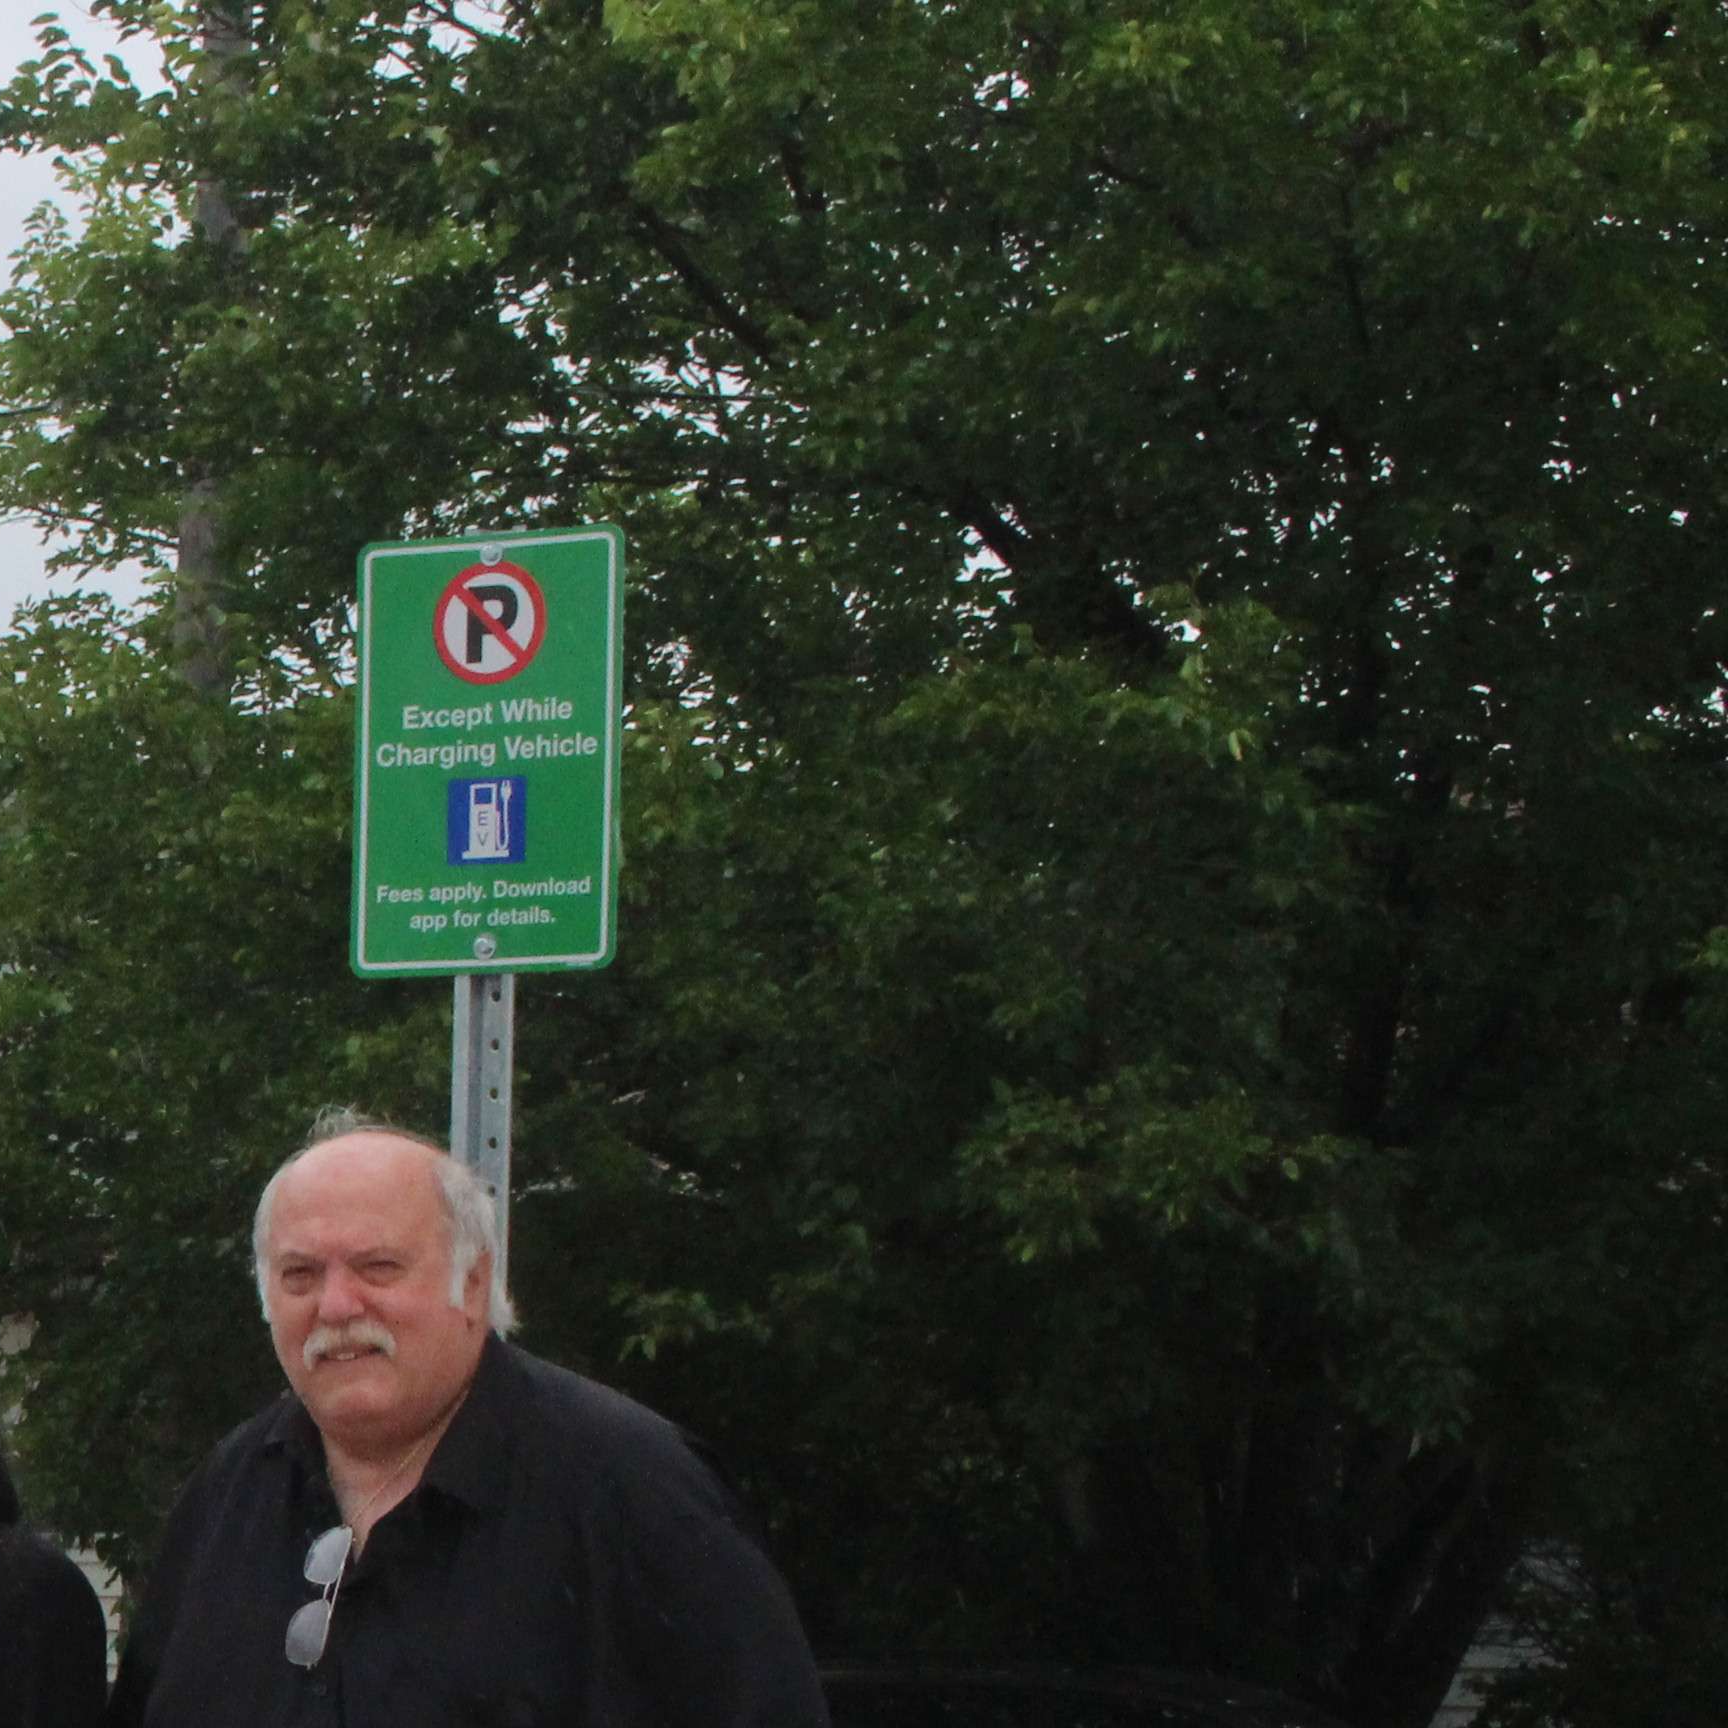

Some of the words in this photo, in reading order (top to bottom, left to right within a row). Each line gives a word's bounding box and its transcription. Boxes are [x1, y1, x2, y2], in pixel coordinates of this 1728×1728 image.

[402, 703, 494, 730] Except
[501, 697, 573, 723] While
[376, 742, 497, 769] Charging
[504, 732, 598, 760] Vehicle
[376, 885, 423, 903] Fees
[429, 884, 487, 906] apply.
[493, 876, 591, 898] Download
[409, 914, 447, 932] app
[452, 911, 482, 929] for
[486, 908, 557, 926] details.
